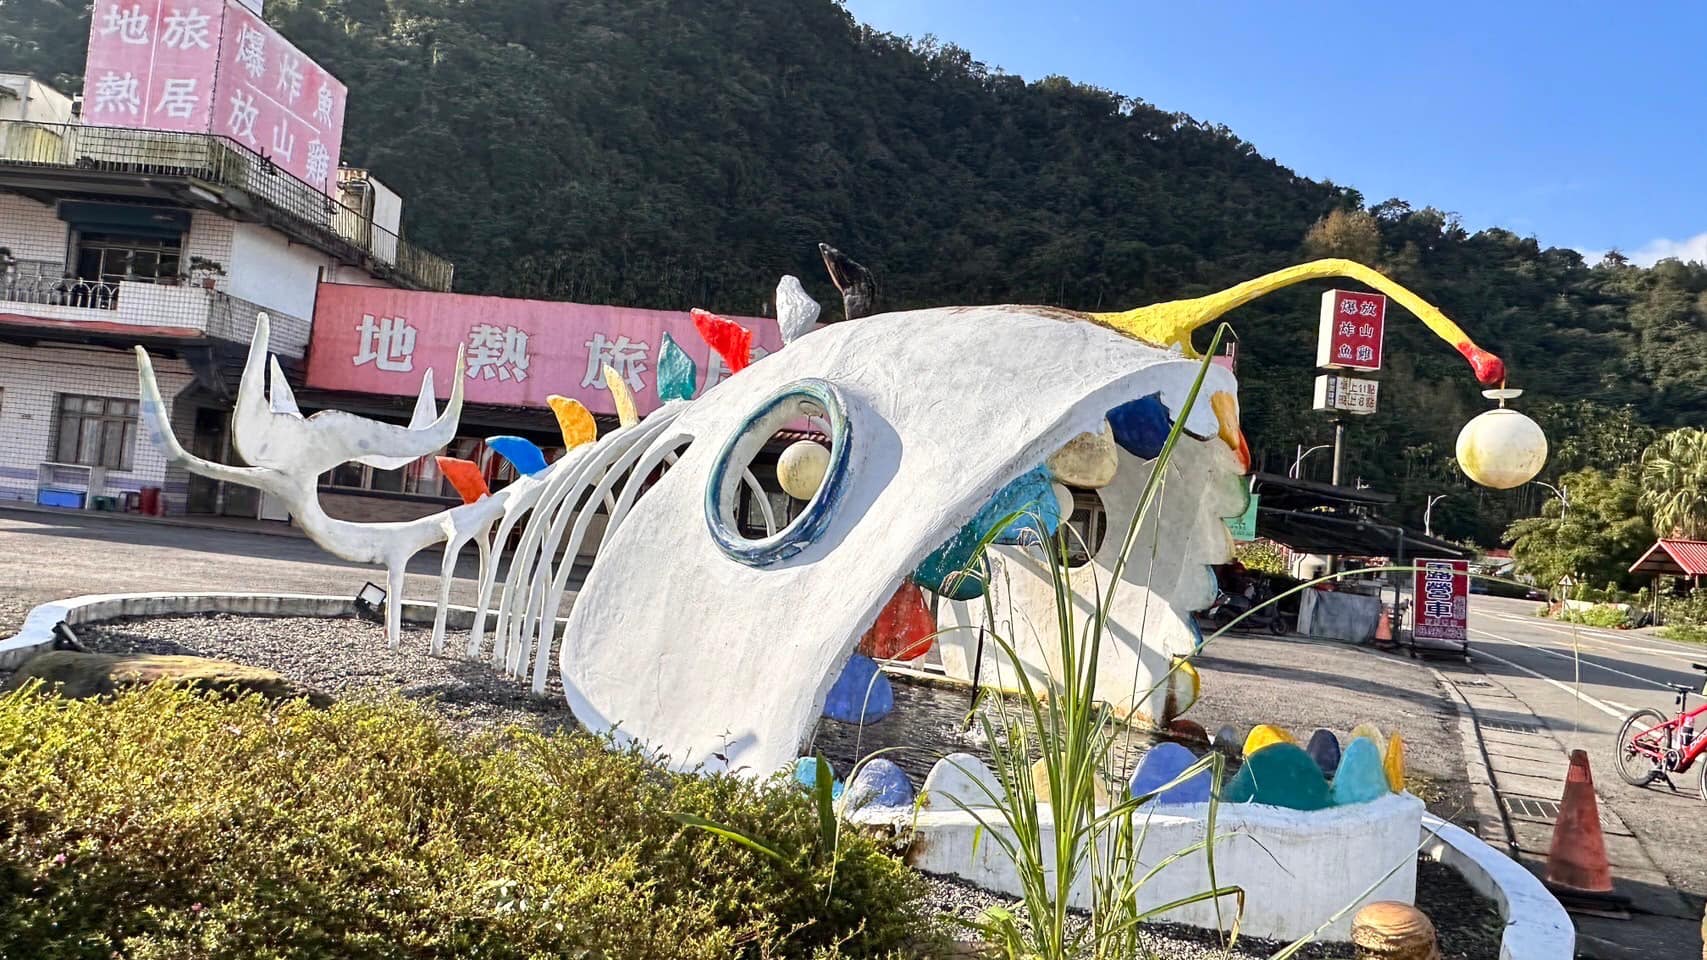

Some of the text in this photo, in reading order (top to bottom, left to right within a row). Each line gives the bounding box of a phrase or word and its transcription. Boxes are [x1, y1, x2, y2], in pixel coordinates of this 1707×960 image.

[235, 23, 333, 128] 爆炸魚
[1424, 562, 1454, 618] 露營車
